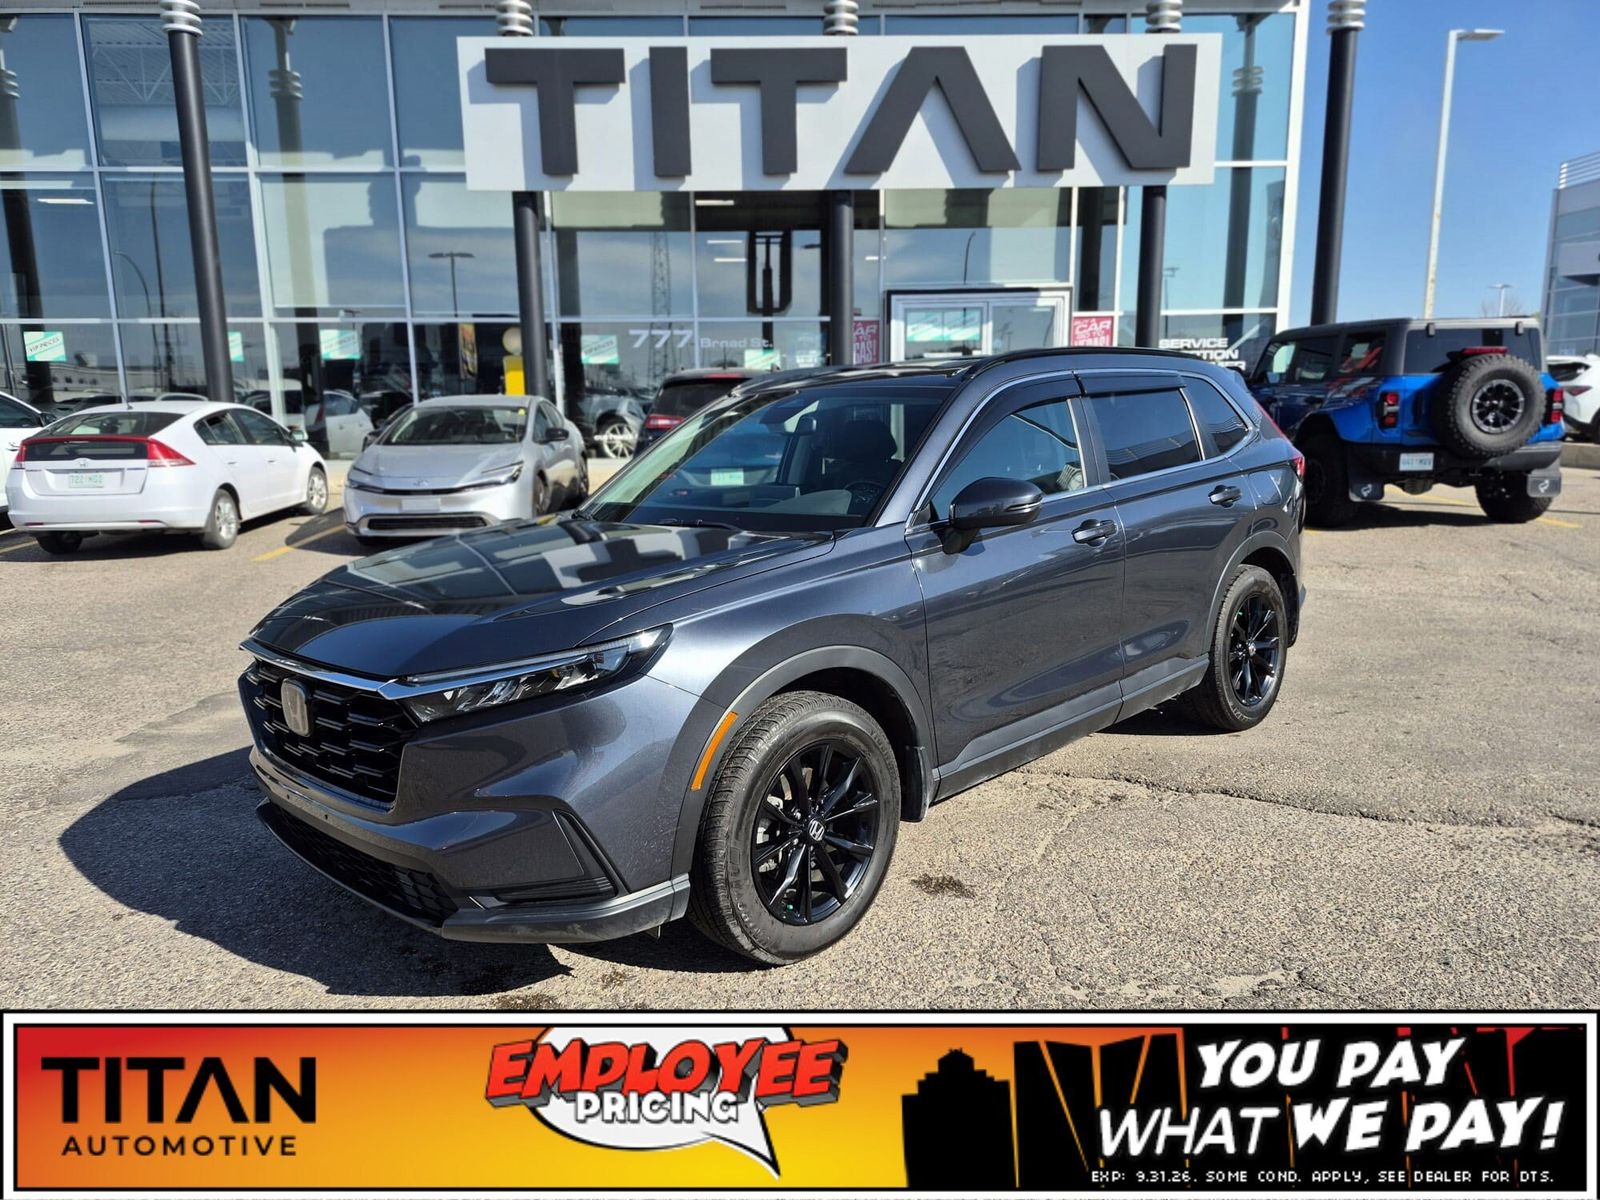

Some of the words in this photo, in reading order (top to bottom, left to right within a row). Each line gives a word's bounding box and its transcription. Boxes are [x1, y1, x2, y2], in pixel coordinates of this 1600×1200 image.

[485, 44, 1197, 177] TITAN
[854, 325, 878, 336] AR
[1075, 321, 1112, 335] CAR
[629, 329, 693, 349] 777
[750, 338, 774, 348] St.
[1159, 338, 1228, 349] SERVICE
[853, 341, 877, 365] GAS!
